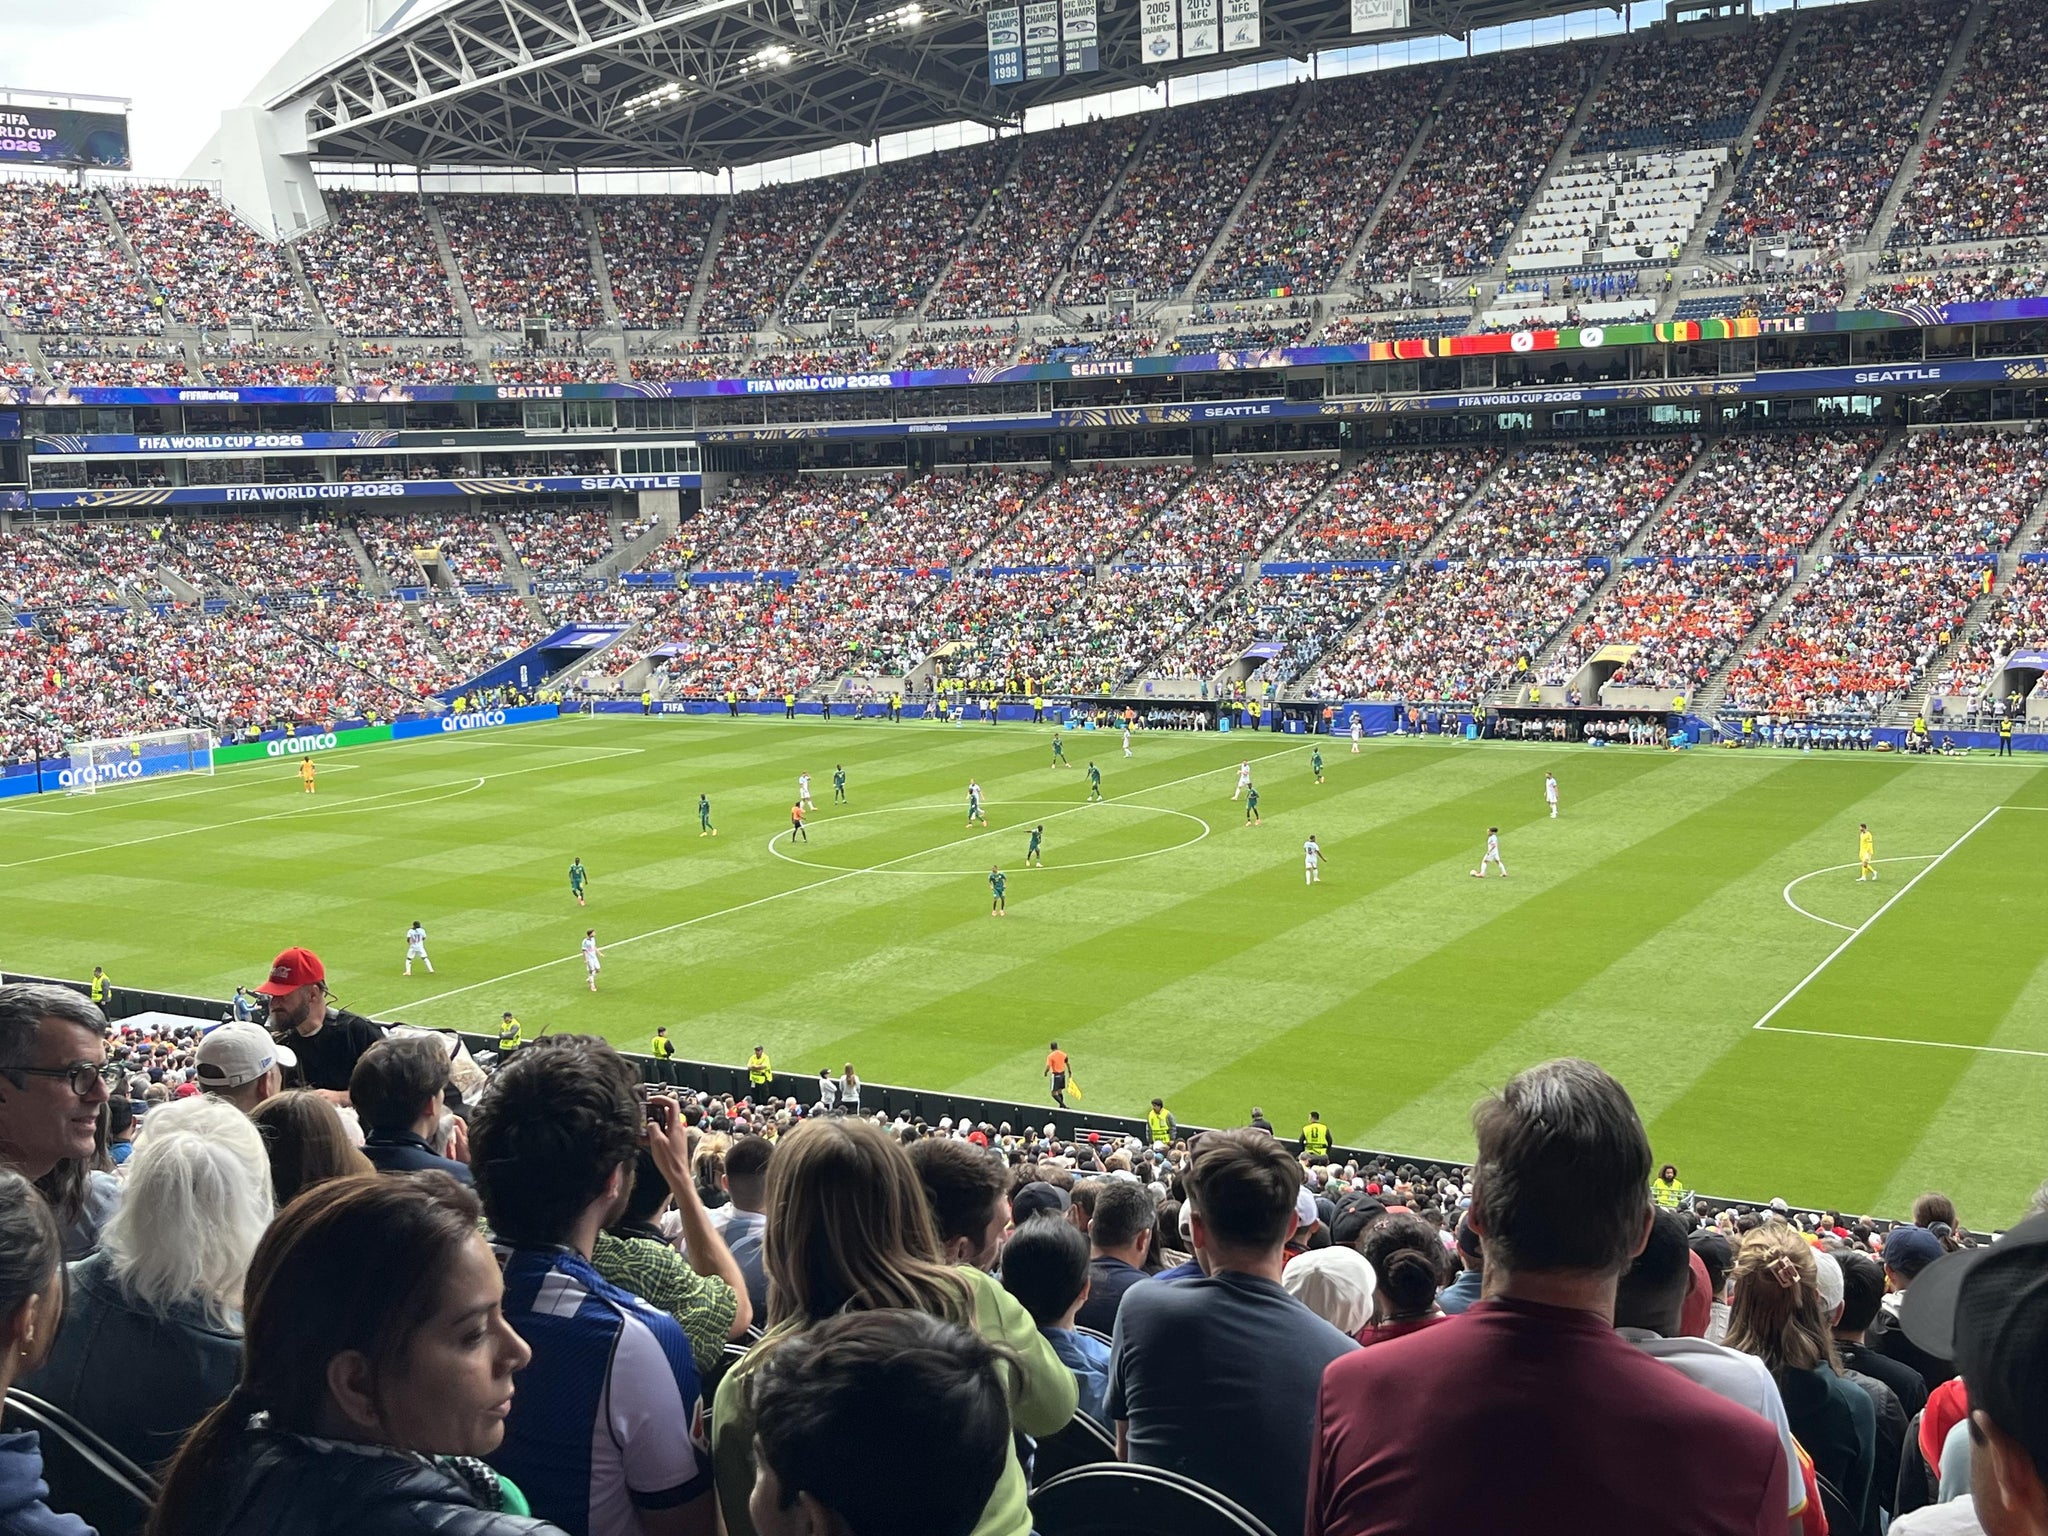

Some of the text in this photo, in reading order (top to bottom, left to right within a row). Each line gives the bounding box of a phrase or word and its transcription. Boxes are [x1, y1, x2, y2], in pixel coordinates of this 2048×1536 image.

[1040, 4, 1056, 13] WEST
[1064, 0, 1075, 8] NFC
[1147, 3, 1170, 14] 2005
[1232, 3, 1249, 13] NFC
[989, 10, 1018, 20] AFC WEST
[1026, 12, 1056, 24] CHAMPS
[1064, 6, 1095, 19] CHAMPS
[1191, 9, 1208, 19] NFC
[1224, 12, 1258, 23] CHAMPIONS
[989, 18, 1018, 30] CHAMPS
[1150, 14, 1167, 24] NFC
[1183, 18, 1216, 30] CHAMPIONS
[1142, 23, 1175, 34] CHAMPIONS
[994, 52, 1016, 65] 1988
[1066, 52, 1079, 60] 2014
[995, 66, 1017, 79] 1999
[0, 113, 29, 126] FIFA
[0, 128, 56, 140] RLD CUP
[1759, 237, 1784, 246] 336
[1416, 266, 1439, 274] 334
[1071, 361, 1133, 377] SEATTLE
[1855, 368, 1940, 383] SEATTLE
[747, 374, 892, 392] FIFA WORLD CUP 2026
[179, 390, 239, 401] #FIFAWorldCup
[497, 385, 562, 399] SEATTLE
[1458, 392, 1581, 406] FIFA WORLD CUP 2026
[1205, 405, 1270, 418] SEATTLE
[139, 435, 304, 449] FIFA WORLD CUP 2026
[580, 476, 680, 490] SEATTLE
[226, 484, 405, 500] FIFA WORLD CUP 2026
[663, 703, 685, 712] FIFA
[442, 710, 506, 731] aramco
[267, 732, 337, 756] aramco
[58, 760, 142, 787] aramco
